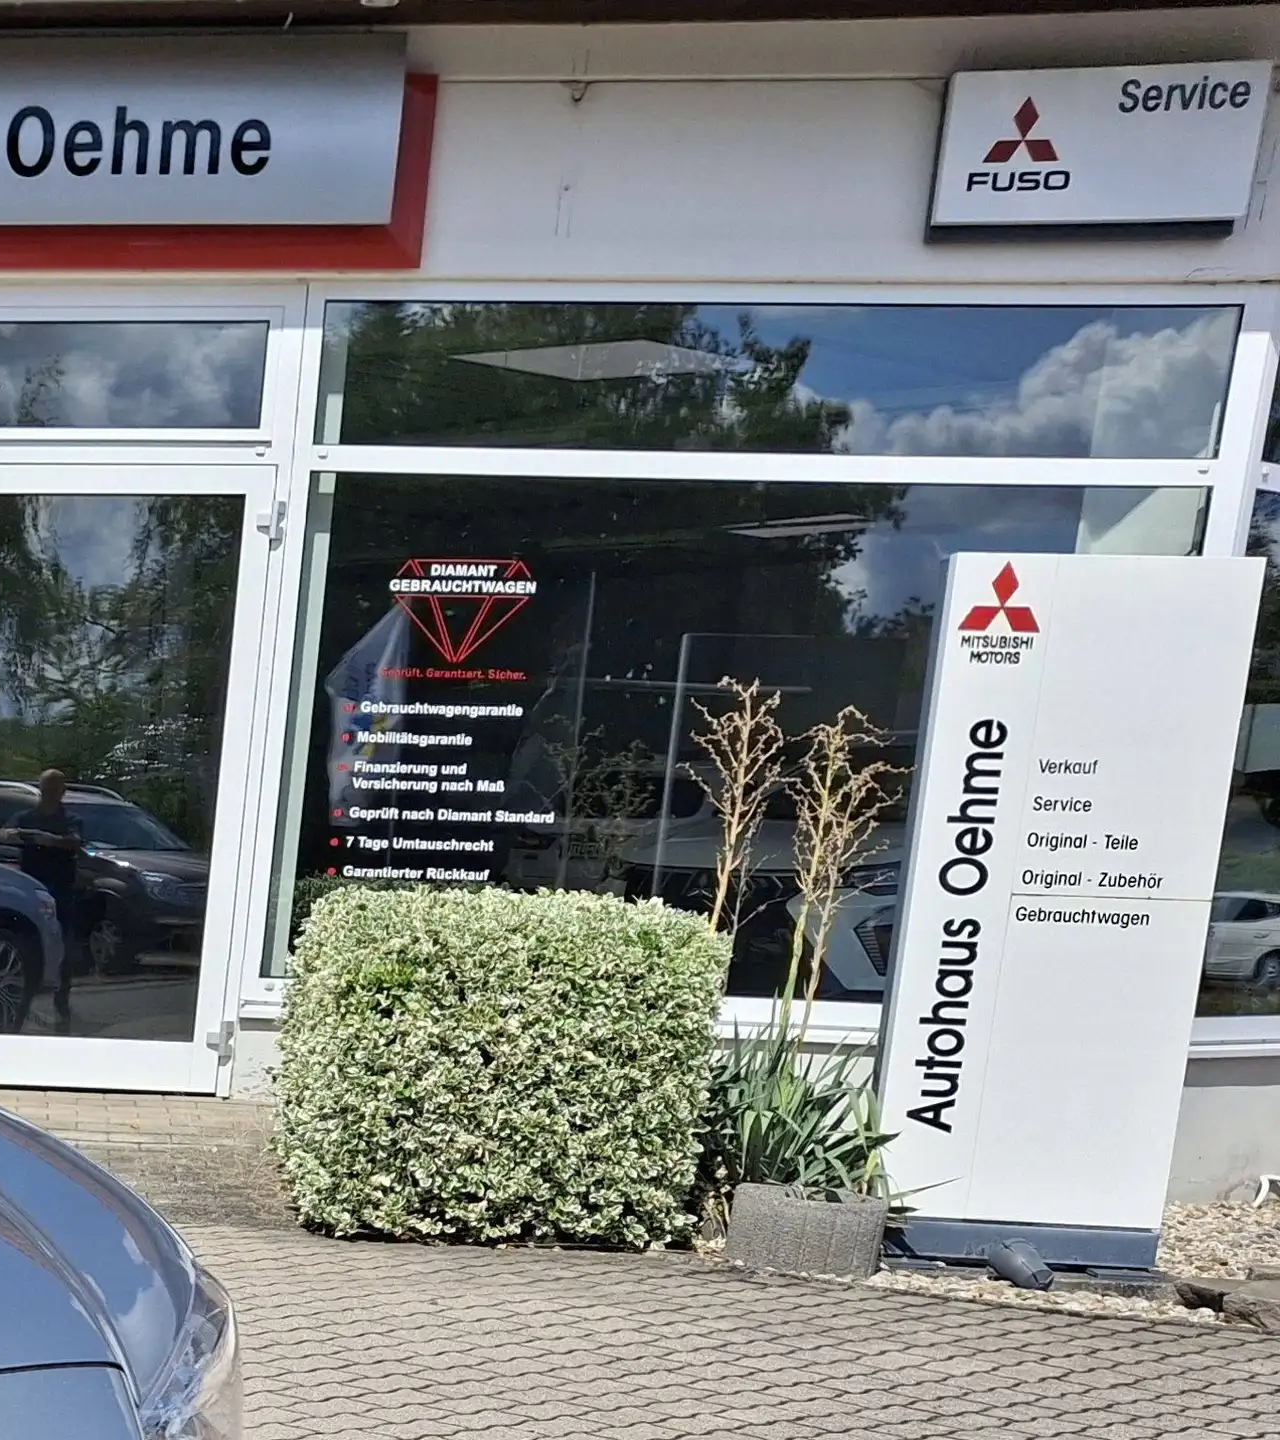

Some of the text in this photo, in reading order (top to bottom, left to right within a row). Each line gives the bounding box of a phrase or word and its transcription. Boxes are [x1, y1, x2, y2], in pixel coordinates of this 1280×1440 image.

[1118, 76, 1252, 114] Service
[5, 105, 273, 178] Oehme
[966, 170, 1072, 193] FUSO
[431, 564, 498, 578] DIAMANT
[389, 578, 537, 594] GEBRAUCHTWAGEN
[960, 635, 1034, 650] MITSUBISHI
[969, 651, 1021, 665] MOTORS
[488, 668, 527, 681] Sicher.
[360, 700, 523, 718] Gebrauchtwagengarantie
[357, 731, 473, 747] Mobilitätsgarantie
[353, 761, 467, 777] Finanzierung und
[1038, 758, 1099, 775] Verkauf
[352, 777, 505, 794] Versicherung nach Maß
[1032, 796, 1093, 813] Service
[349, 807, 555, 824] Geprüft nach Diamant Standard
[346, 836, 494, 852] 7 Tage Umtauschrecht
[1027, 832, 1088, 852] Original
[1104, 834, 1139, 851] Teile
[343, 865, 490, 881] Garantierter Rückkauf
[1021, 869, 1083, 888] Original
[1097, 872, 1164, 890] Zubehör
[1015, 907, 1151, 927] Gebrauchtwagen
[906, 718, 1009, 1134] Autohaus Oehme
